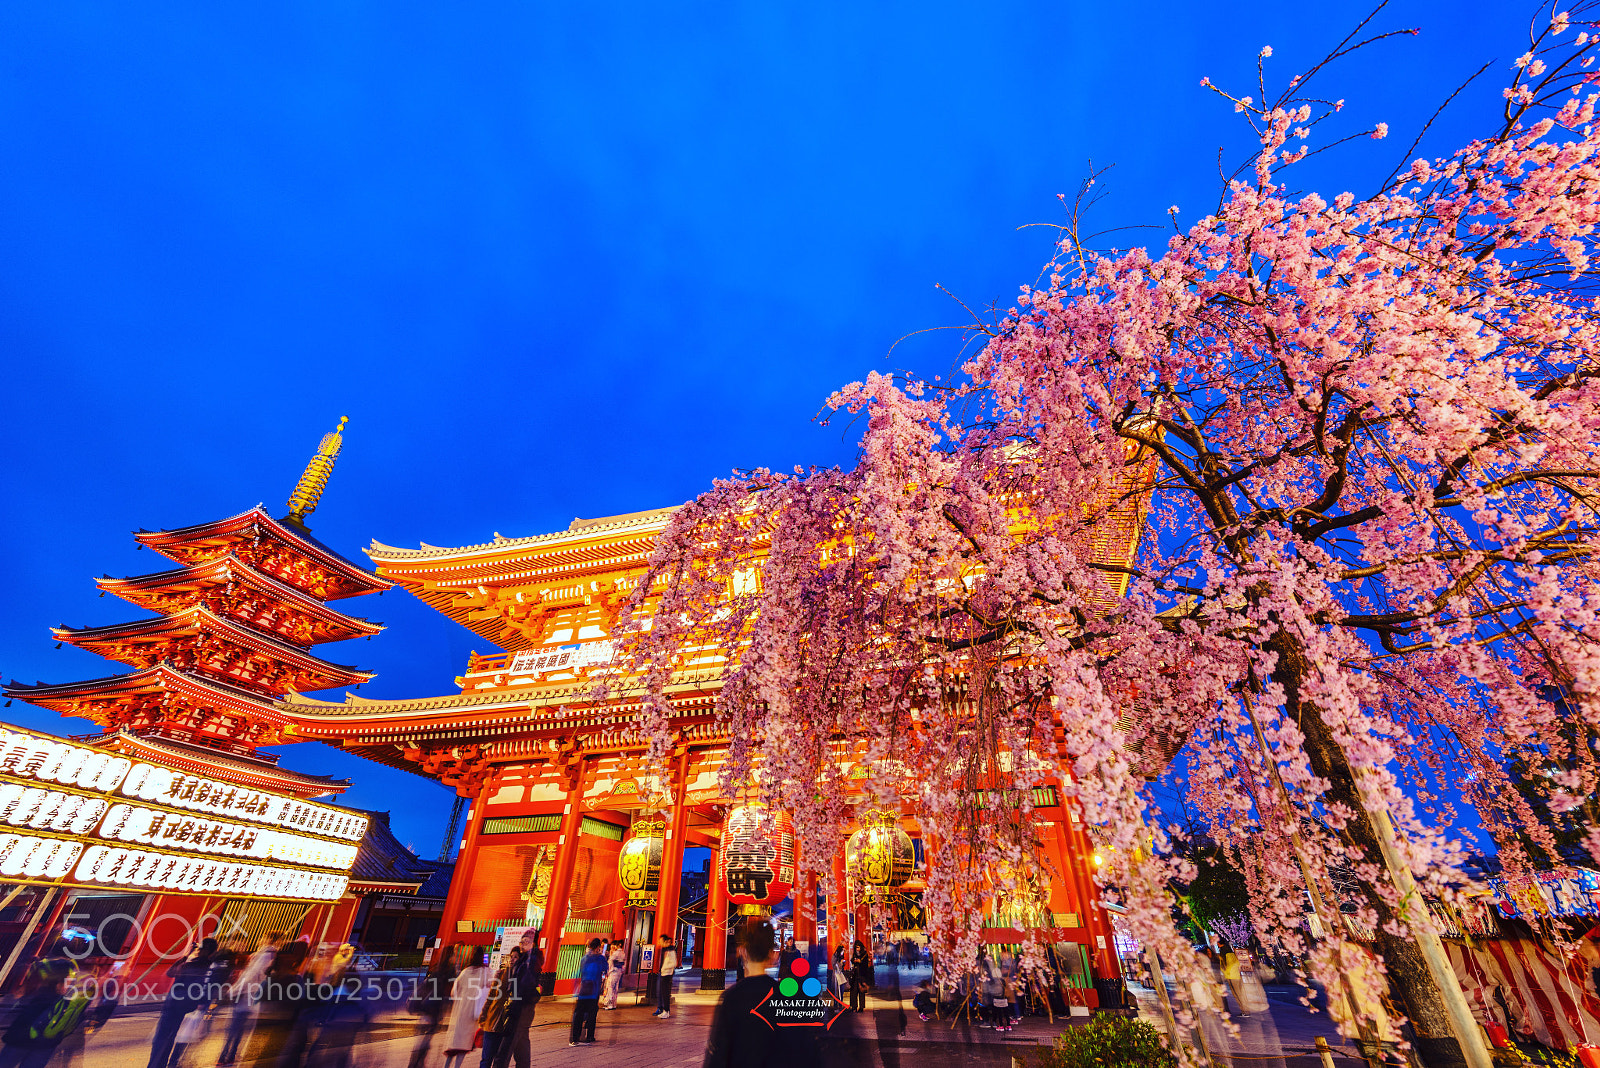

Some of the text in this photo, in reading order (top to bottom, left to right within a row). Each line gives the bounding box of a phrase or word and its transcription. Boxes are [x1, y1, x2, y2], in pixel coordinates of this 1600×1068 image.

[512, 652, 570, 672] 伝法院庭園
